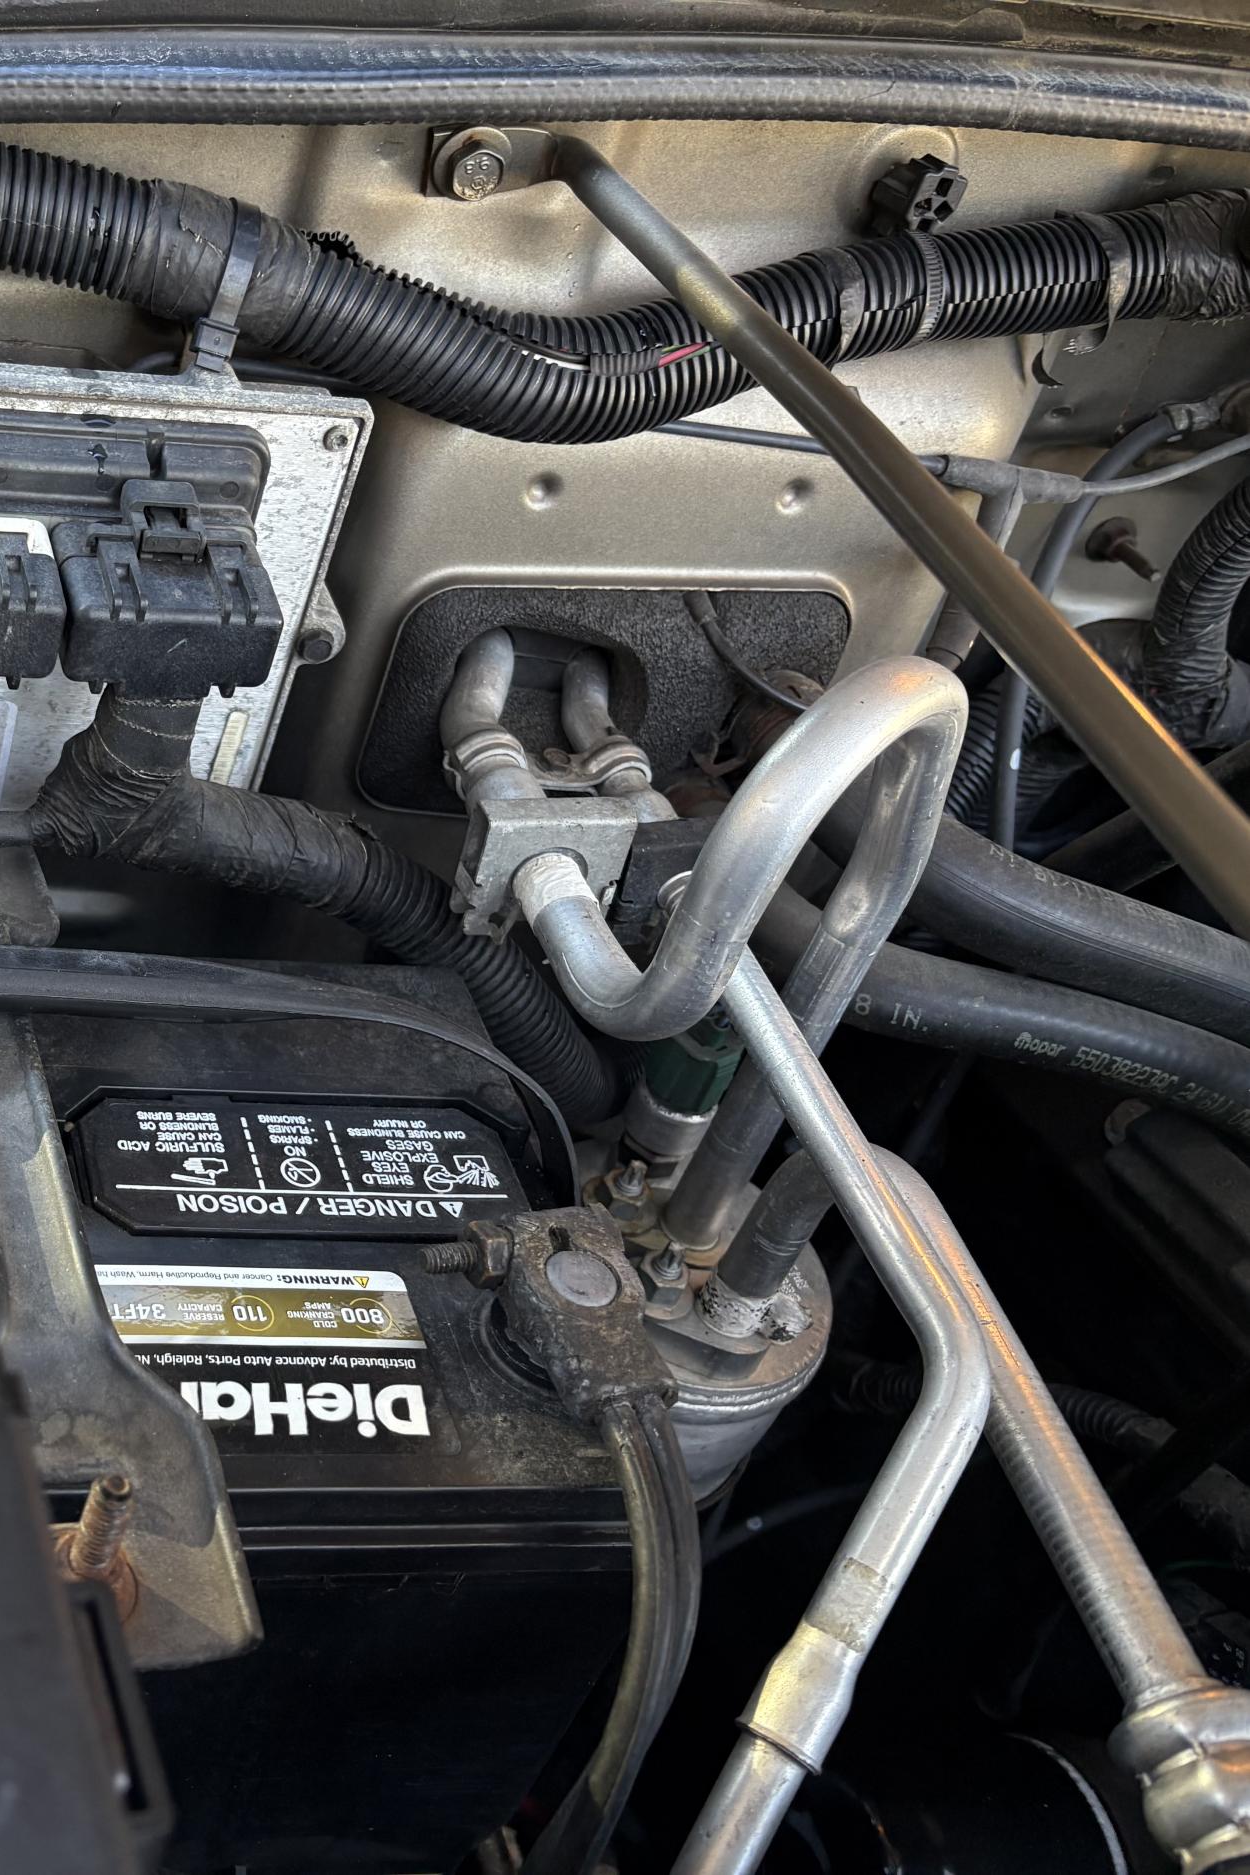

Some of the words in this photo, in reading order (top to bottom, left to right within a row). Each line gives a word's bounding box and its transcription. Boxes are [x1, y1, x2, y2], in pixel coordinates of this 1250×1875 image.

[136, 1110, 173, 1120] BURNS
[175, 1112, 216, 1122] SEVERE
[257, 1114, 306, 1124] SMOKING
[138, 1121, 156, 1130] OR
[158, 1122, 219, 1131] BLINDNESS
[372, 1119, 409, 1128] INJURY
[410, 1120, 426, 1128] OR
[266, 1124, 310, 1134] FLAMES
[346, 1128, 406, 1138] BLINDNESS
[156, 1132, 196, 1141] CAUSE
[198, 1132, 222, 1141] CAN
[268, 1134, 313, 1144] SPARKS
[406, 1130, 442, 1139] CAUSE
[444, 1130, 466, 1140] CAN
[116, 1140, 150, 1152] ACID
[154, 1141, 225, 1154] SULFURIC
[283, 1145, 306, 1156] NO
[385, 1139, 434, 1152] GASES
[360, 1150, 439, 1164] EXPLOSIVE
[371, 1162, 410, 1173] EYES
[362, 1173, 414, 1186] SHIELD
[176, 1194, 288, 1214] POISON
[295, 1197, 310, 1215] /
[316, 1198, 438, 1218] DANGER
[110, 1270, 135, 1278] Wash
[164, 1270, 221, 1280] Reproductive
[223, 1273, 240, 1282] and
[242, 1274, 273, 1282] Cancer
[276, 1274, 354, 1286] WARNING:
[108, 1302, 166, 1320] 34FT
[177, 1302, 223, 1312] CAPACITY
[182, 1312, 225, 1322] RESERVE
[231, 1304, 268, 1322] 110
[286, 1310, 334, 1319] CRANKING
[340, 1307, 385, 1324] 800
[312, 1320, 338, 1328] COLD
[153, 1352, 202, 1366] Raleigh,
[204, 1354, 240, 1366] Parts,
[243, 1355, 272, 1366] Auto
[275, 1356, 326, 1368] Advance
[328, 1354, 348, 1368] by:
[350, 1356, 416, 1369] Distributed
